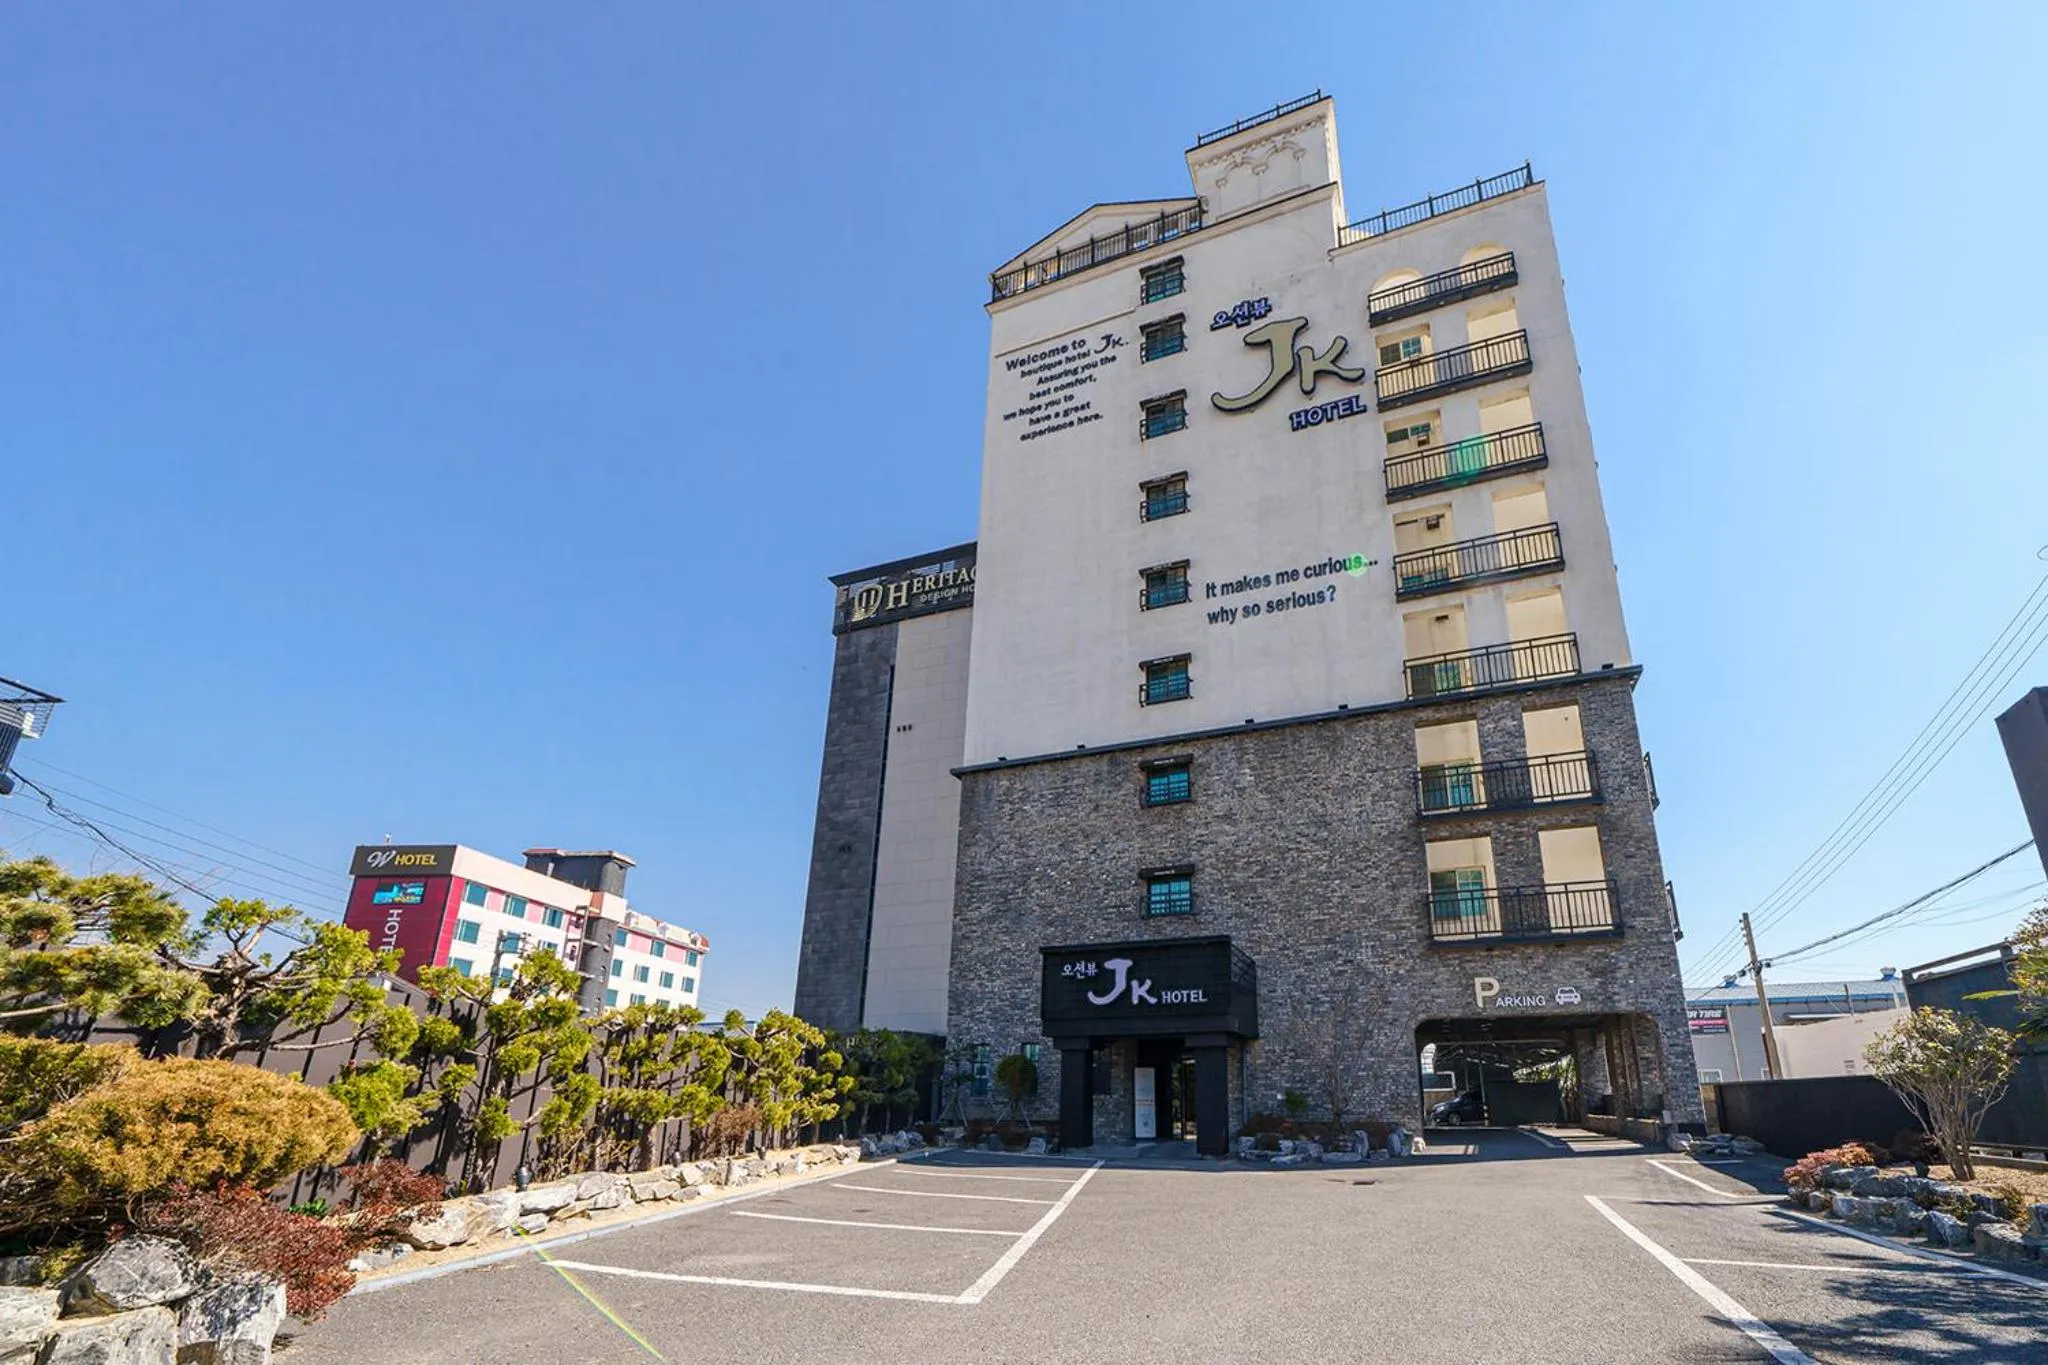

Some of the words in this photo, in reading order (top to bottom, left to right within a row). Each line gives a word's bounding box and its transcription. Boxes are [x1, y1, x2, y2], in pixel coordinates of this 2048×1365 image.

[1005, 344, 1069, 371] Welcome
[1071, 339, 1087, 350] to
[1020, 359, 1063, 378] boutique
[1064, 349, 1091, 364] hotel
[1036, 366, 1079, 386] Assuring
[1081, 360, 1098, 373] you
[1100, 355, 1117, 366] the
[1211, 316, 1366, 412] JK
[1003, 411, 1017, 421] we
[1018, 404, 1042, 416] hope
[1044, 399, 1062, 411] you
[1063, 394, 1075, 402] to
[1029, 387, 1051, 401] best
[1020, 420, 1075, 441] experience
[1077, 412, 1103, 425] here.
[1029, 414, 1052, 426] have
[1062, 401, 1091, 417] great
[1289, 395, 1367, 431] HOTEL
[1205, 582, 1218, 599] It
[1221, 574, 1272, 596] makes
[1276, 568, 1300, 585] me
[1207, 606, 1238, 625] why
[1242, 602, 1261, 618] so
[1266, 584, 1337, 614] serious?
[394, 853, 438, 866] HOTEL
[1087, 958, 1158, 1005] JK
[1162, 990, 1208, 1004] HOTEL
[1474, 977, 1546, 1009] PARKING
